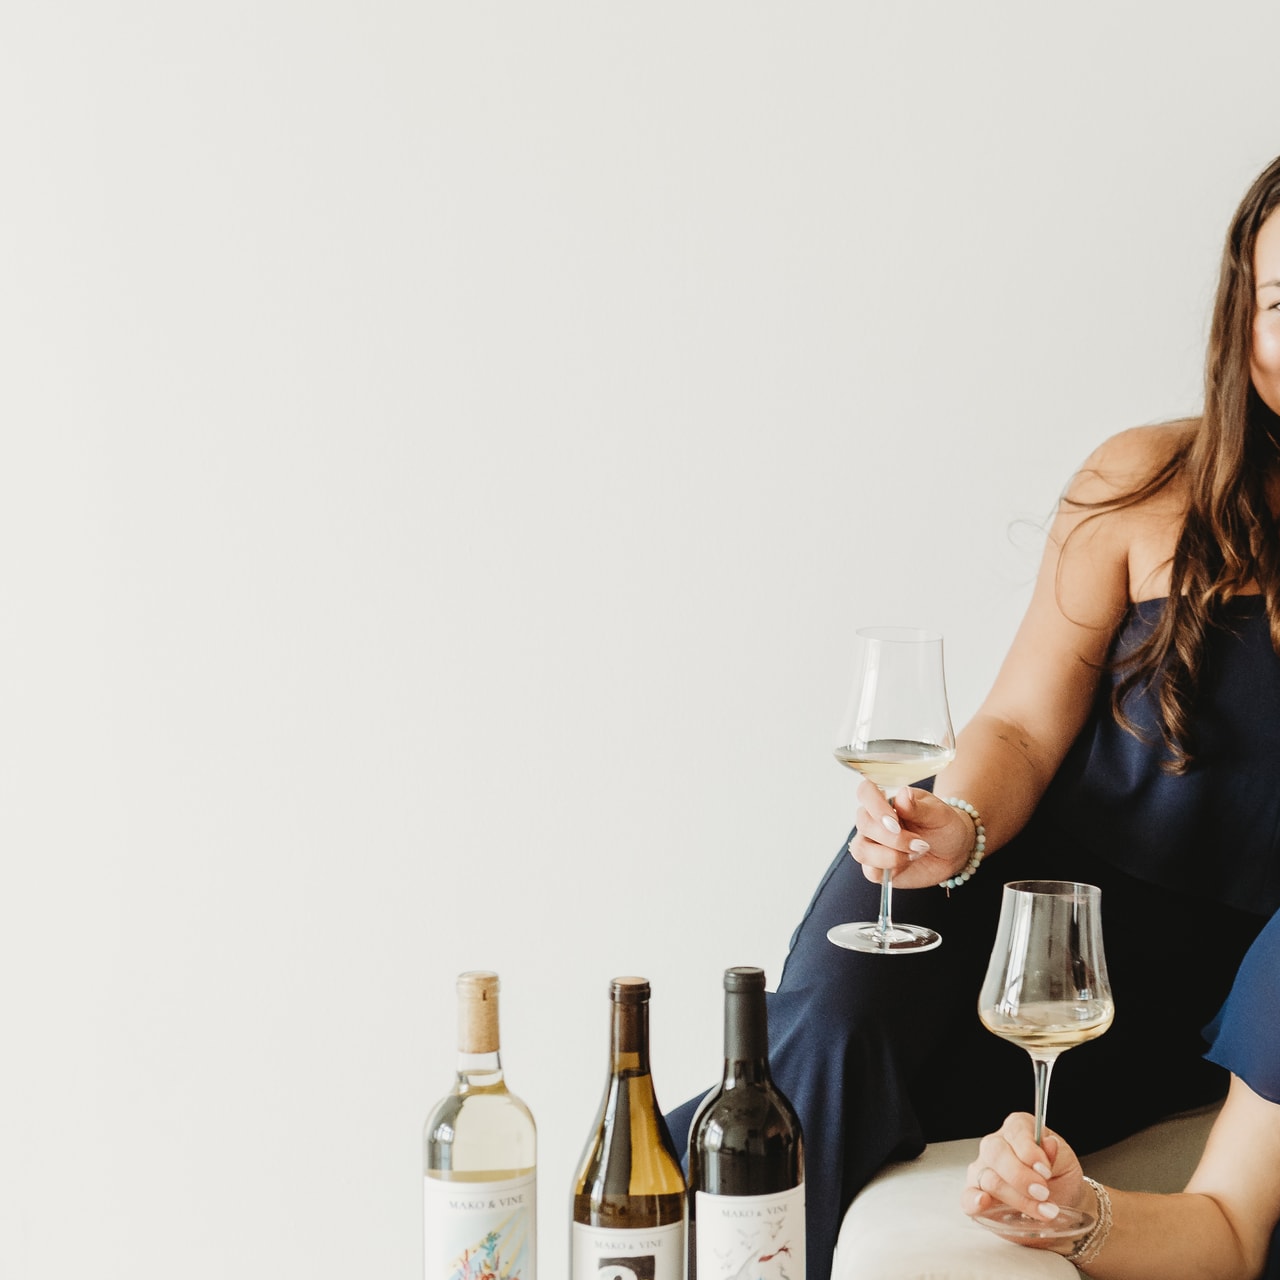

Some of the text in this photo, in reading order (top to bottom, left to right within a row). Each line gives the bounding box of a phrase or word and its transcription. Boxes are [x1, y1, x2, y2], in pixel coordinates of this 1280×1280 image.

[449, 1194, 524, 1210] MAKO & VINE
[721, 1208, 754, 1218] MAKO
[766, 1204, 788, 1216] VINE
[594, 1240, 626, 1250] MAKO
[639, 1239, 664, 1249] VINE
